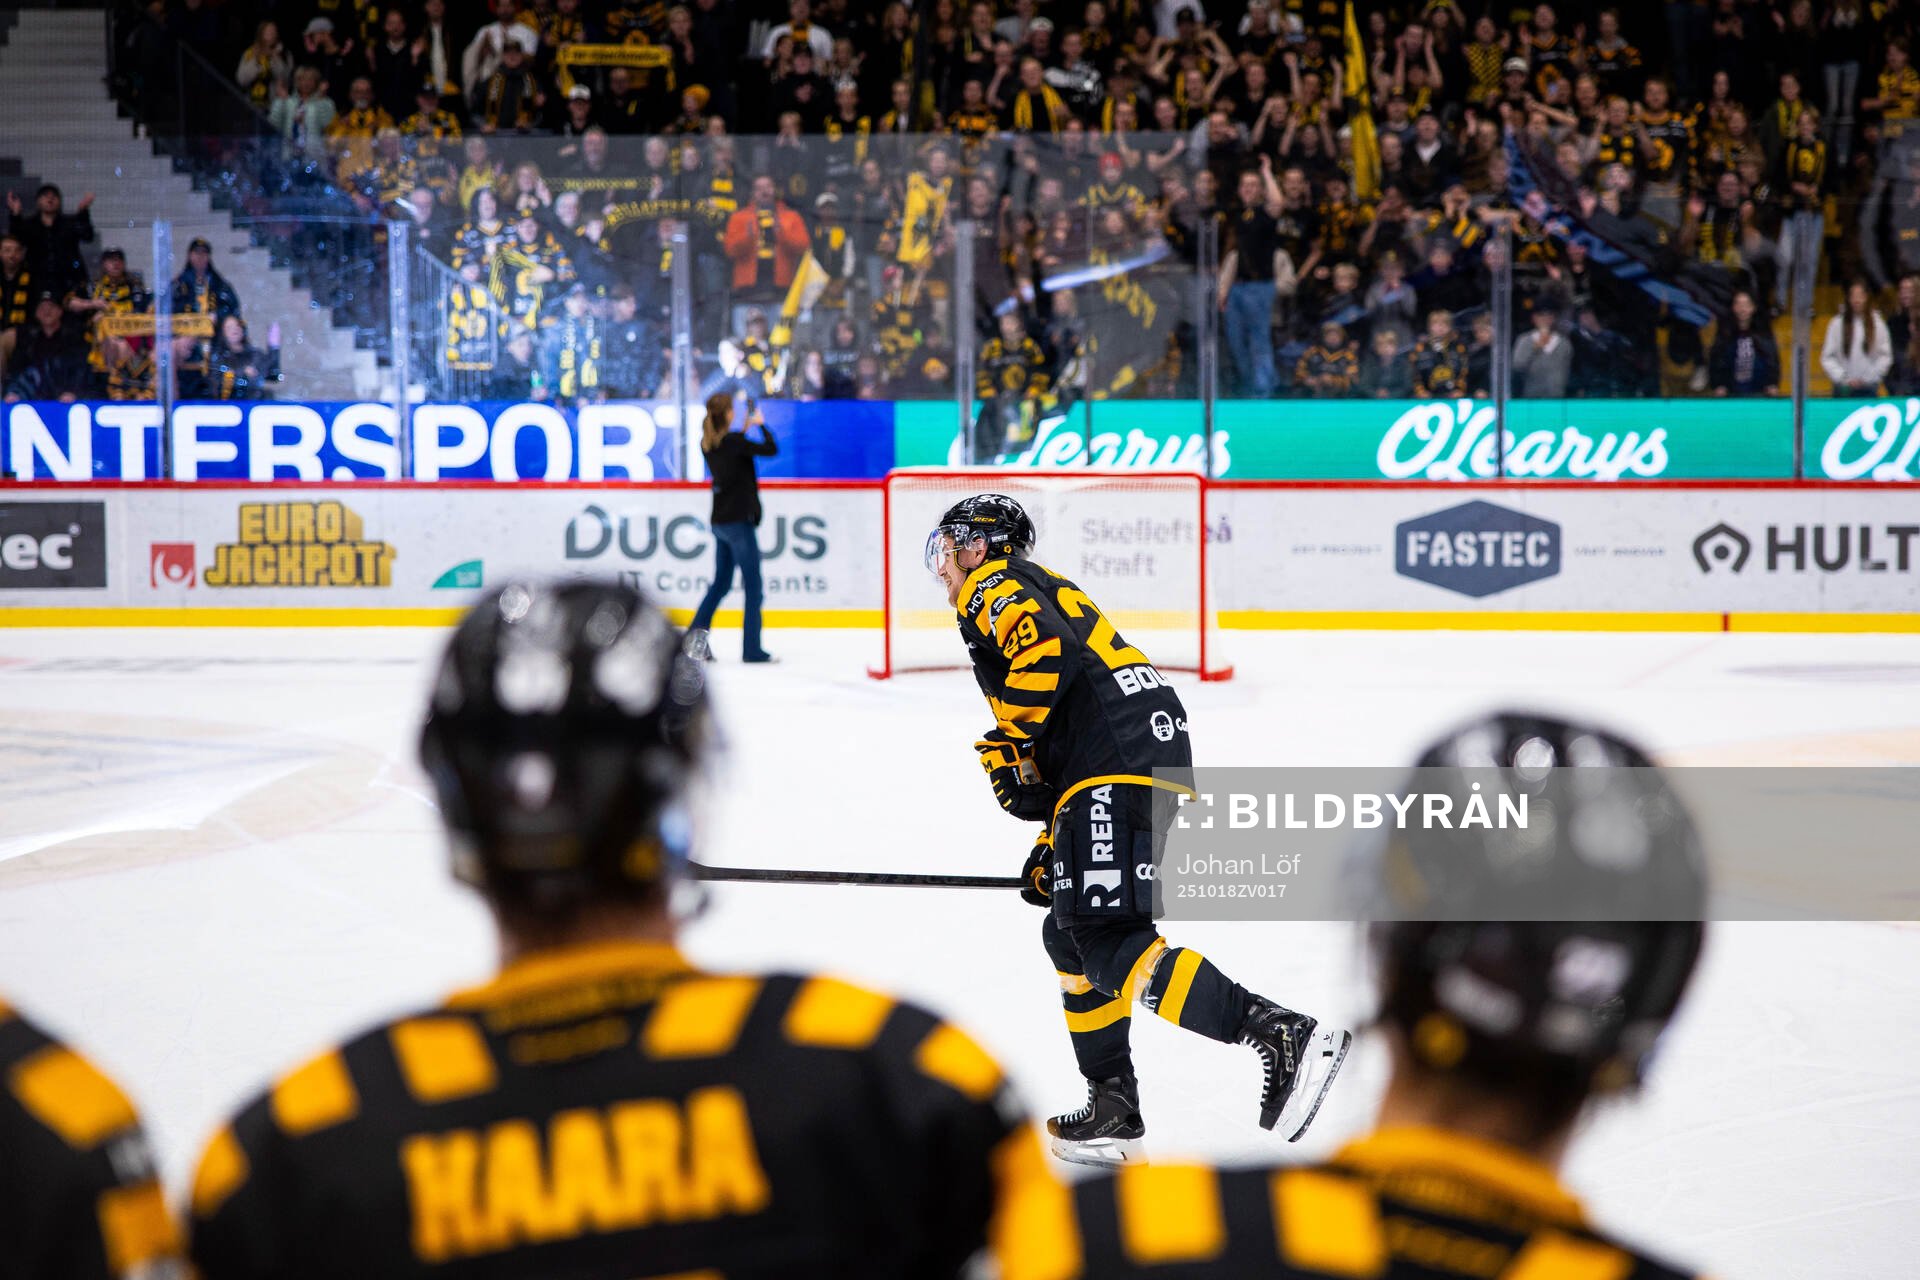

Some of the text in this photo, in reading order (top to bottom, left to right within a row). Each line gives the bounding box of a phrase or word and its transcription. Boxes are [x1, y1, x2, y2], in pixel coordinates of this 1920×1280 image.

[239, 501, 345, 544] EURO
[565, 504, 828, 561] DUCUS
[0, 532, 73, 570] ec
[204, 541, 386, 587] JACKPOT
[1080, 551, 1156, 578] Kraft
[1407, 531, 1551, 568] FASTEC
[1003, 615, 1039, 660] 29
[1090, 783, 1114, 862] REPA
[401, 1084, 771, 1264] KAARA
